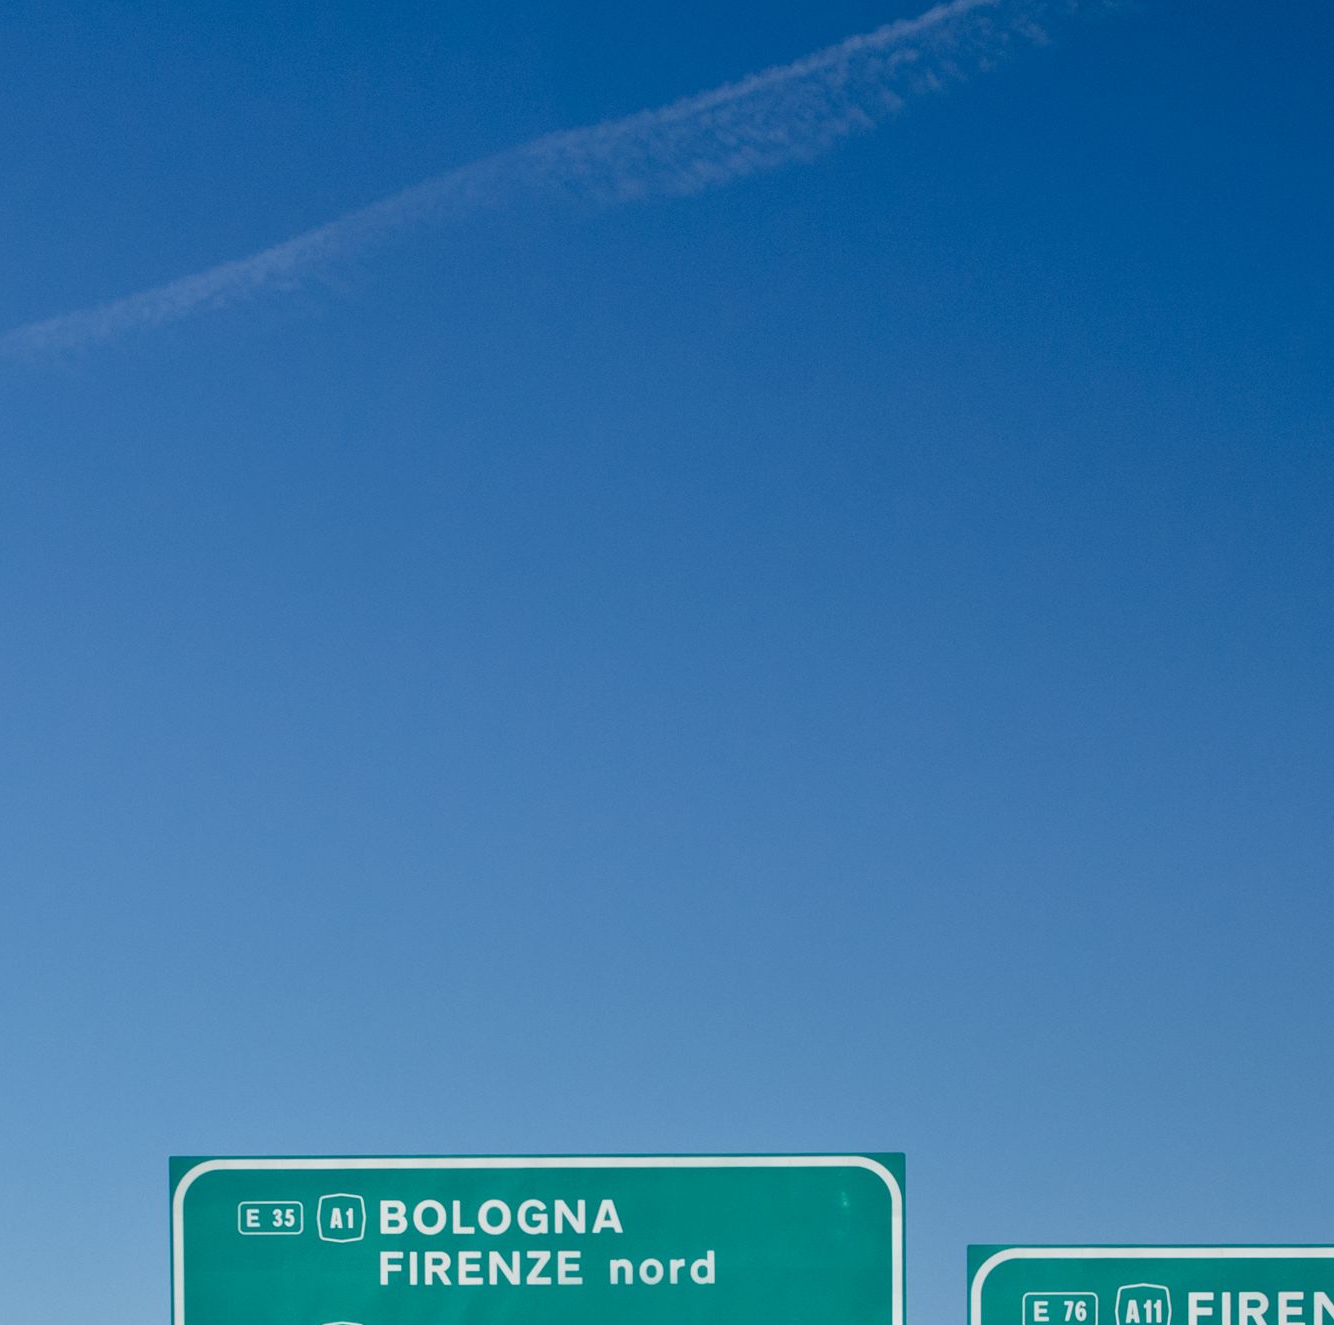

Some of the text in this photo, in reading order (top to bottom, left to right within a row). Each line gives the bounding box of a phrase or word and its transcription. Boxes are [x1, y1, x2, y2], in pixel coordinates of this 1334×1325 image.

[247, 1200, 623, 1235] E 35 A1 BOLOGNA
[380, 1250, 715, 1285] FIRENZE nord
[1034, 1301, 1049, 1321] E
[1064, 1301, 1086, 1321] 76
[1126, 1300, 1162, 1323] A11
